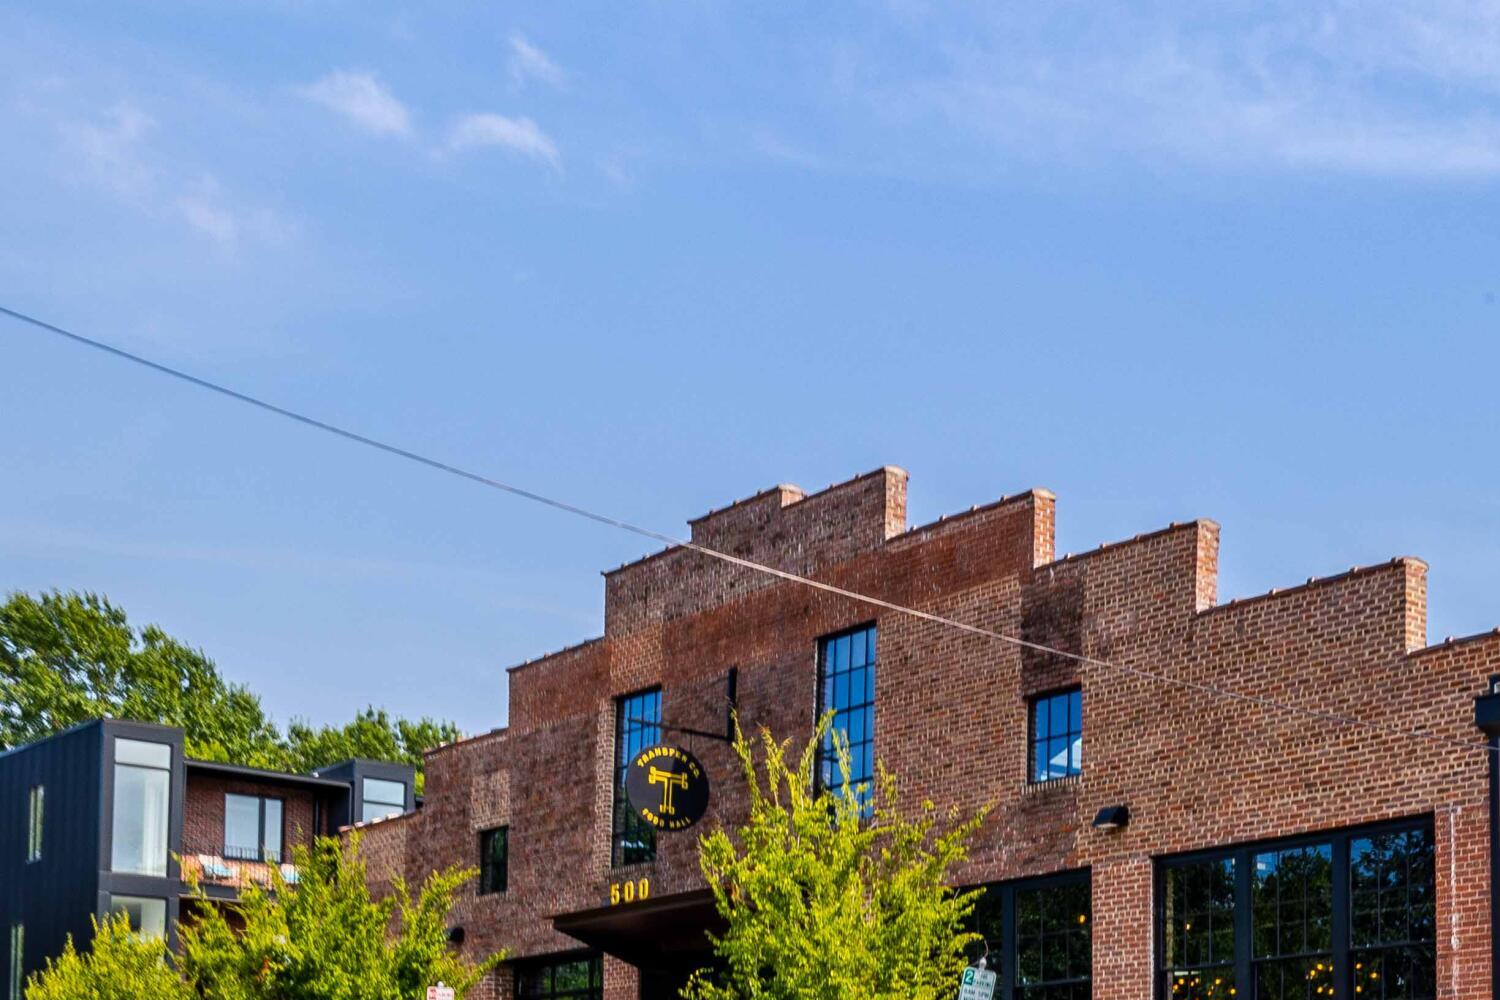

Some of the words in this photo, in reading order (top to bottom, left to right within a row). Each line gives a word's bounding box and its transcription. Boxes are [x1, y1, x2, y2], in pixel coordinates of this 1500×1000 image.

[642, 807, 665, 829] FOOD
[669, 817, 691, 830] HALL
[610, 877, 649, 906] 500
